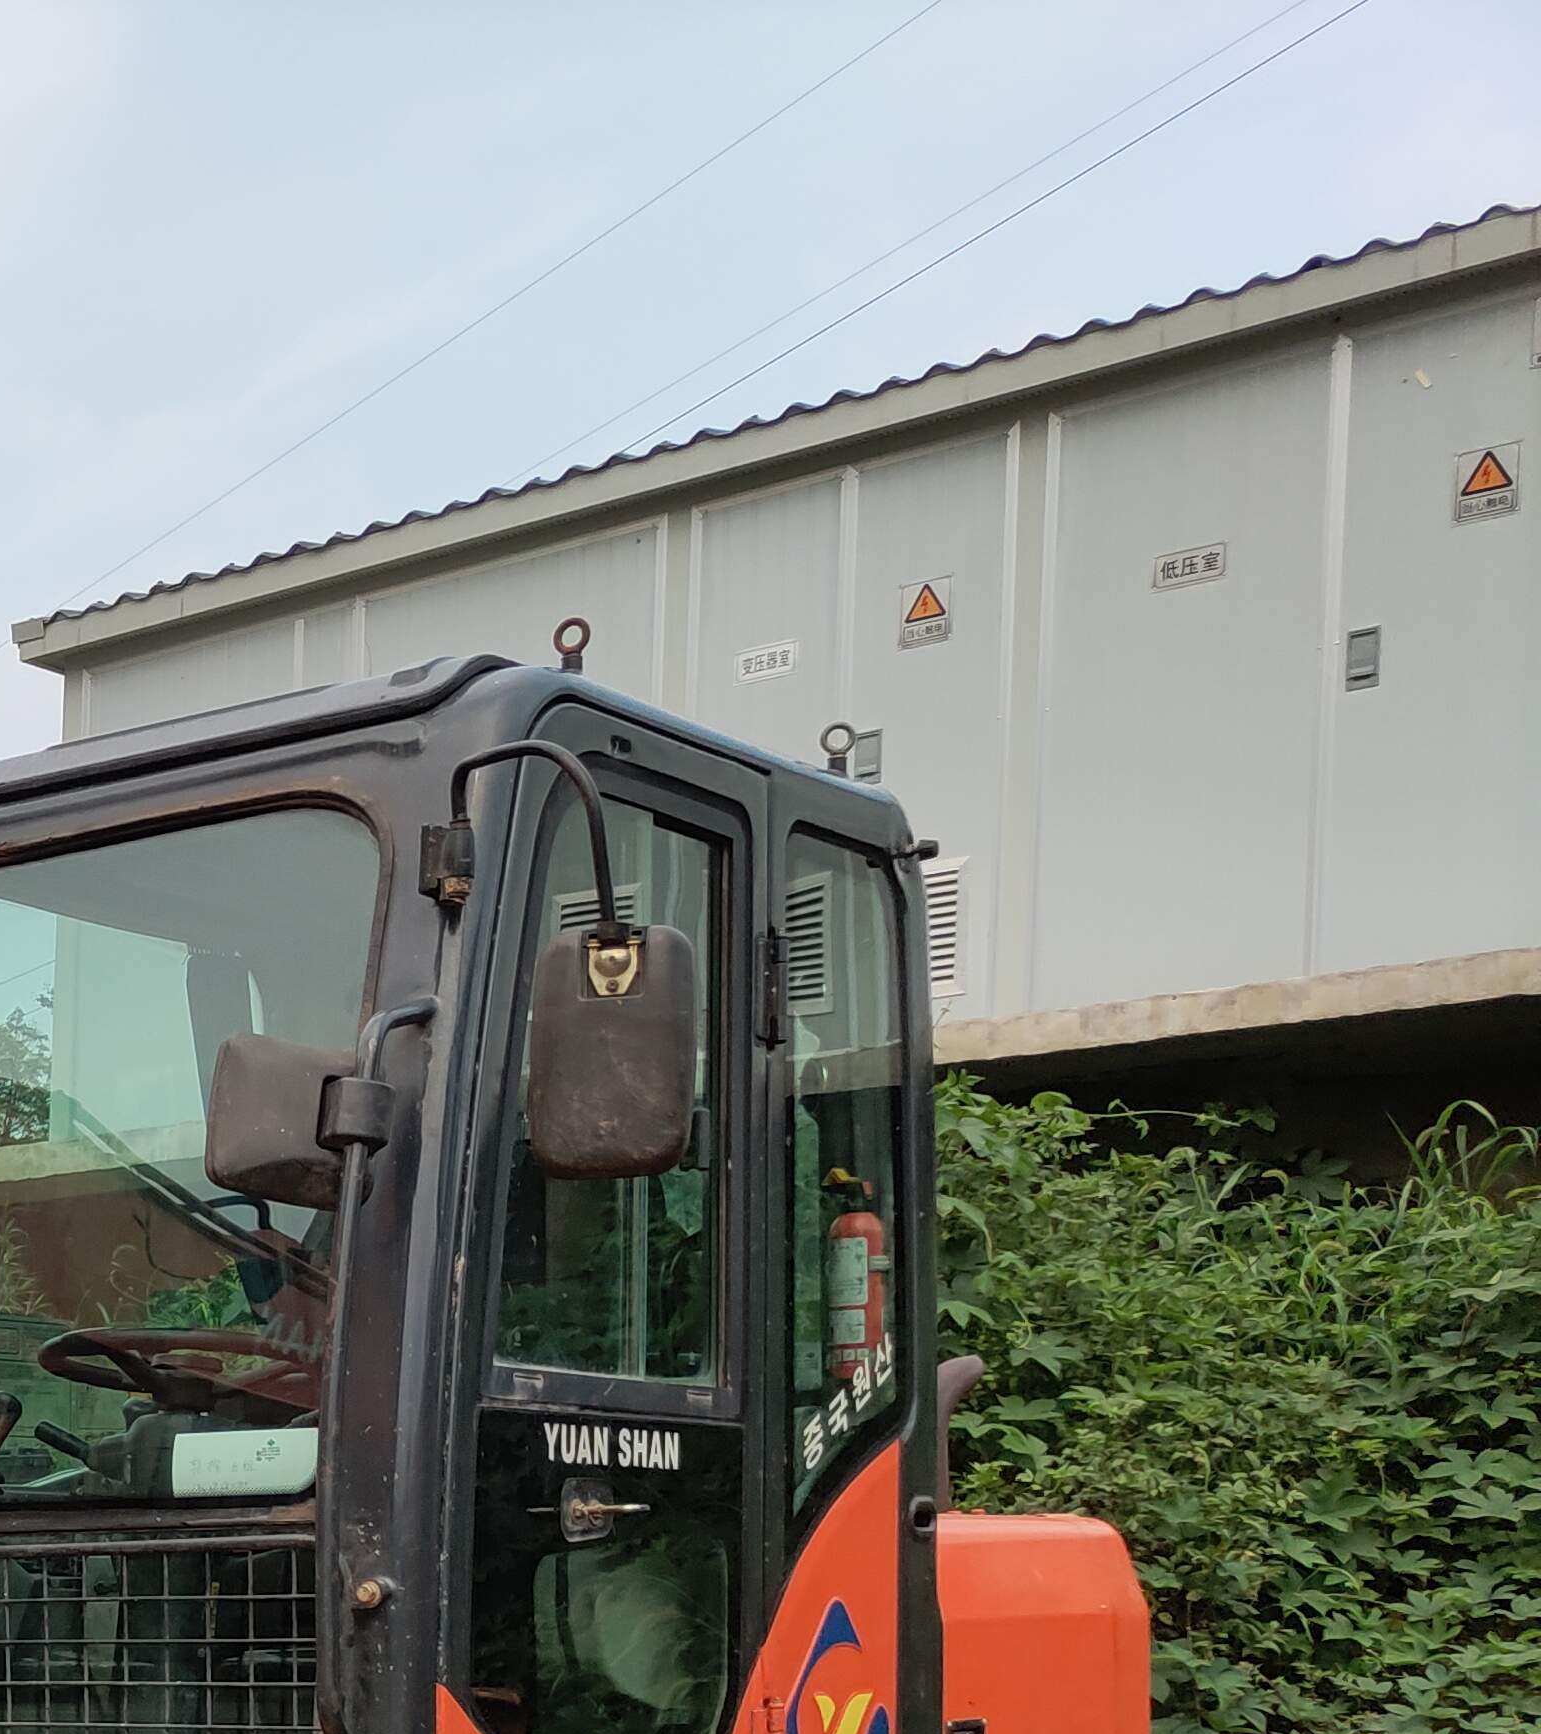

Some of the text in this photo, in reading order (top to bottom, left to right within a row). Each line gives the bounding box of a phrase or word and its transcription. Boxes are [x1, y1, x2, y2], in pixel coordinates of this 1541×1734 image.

[1160, 552, 1221, 581] 低压室
[741, 649, 791, 676] 变压器室
[543, 1422, 680, 1470] YUAN SHAN
